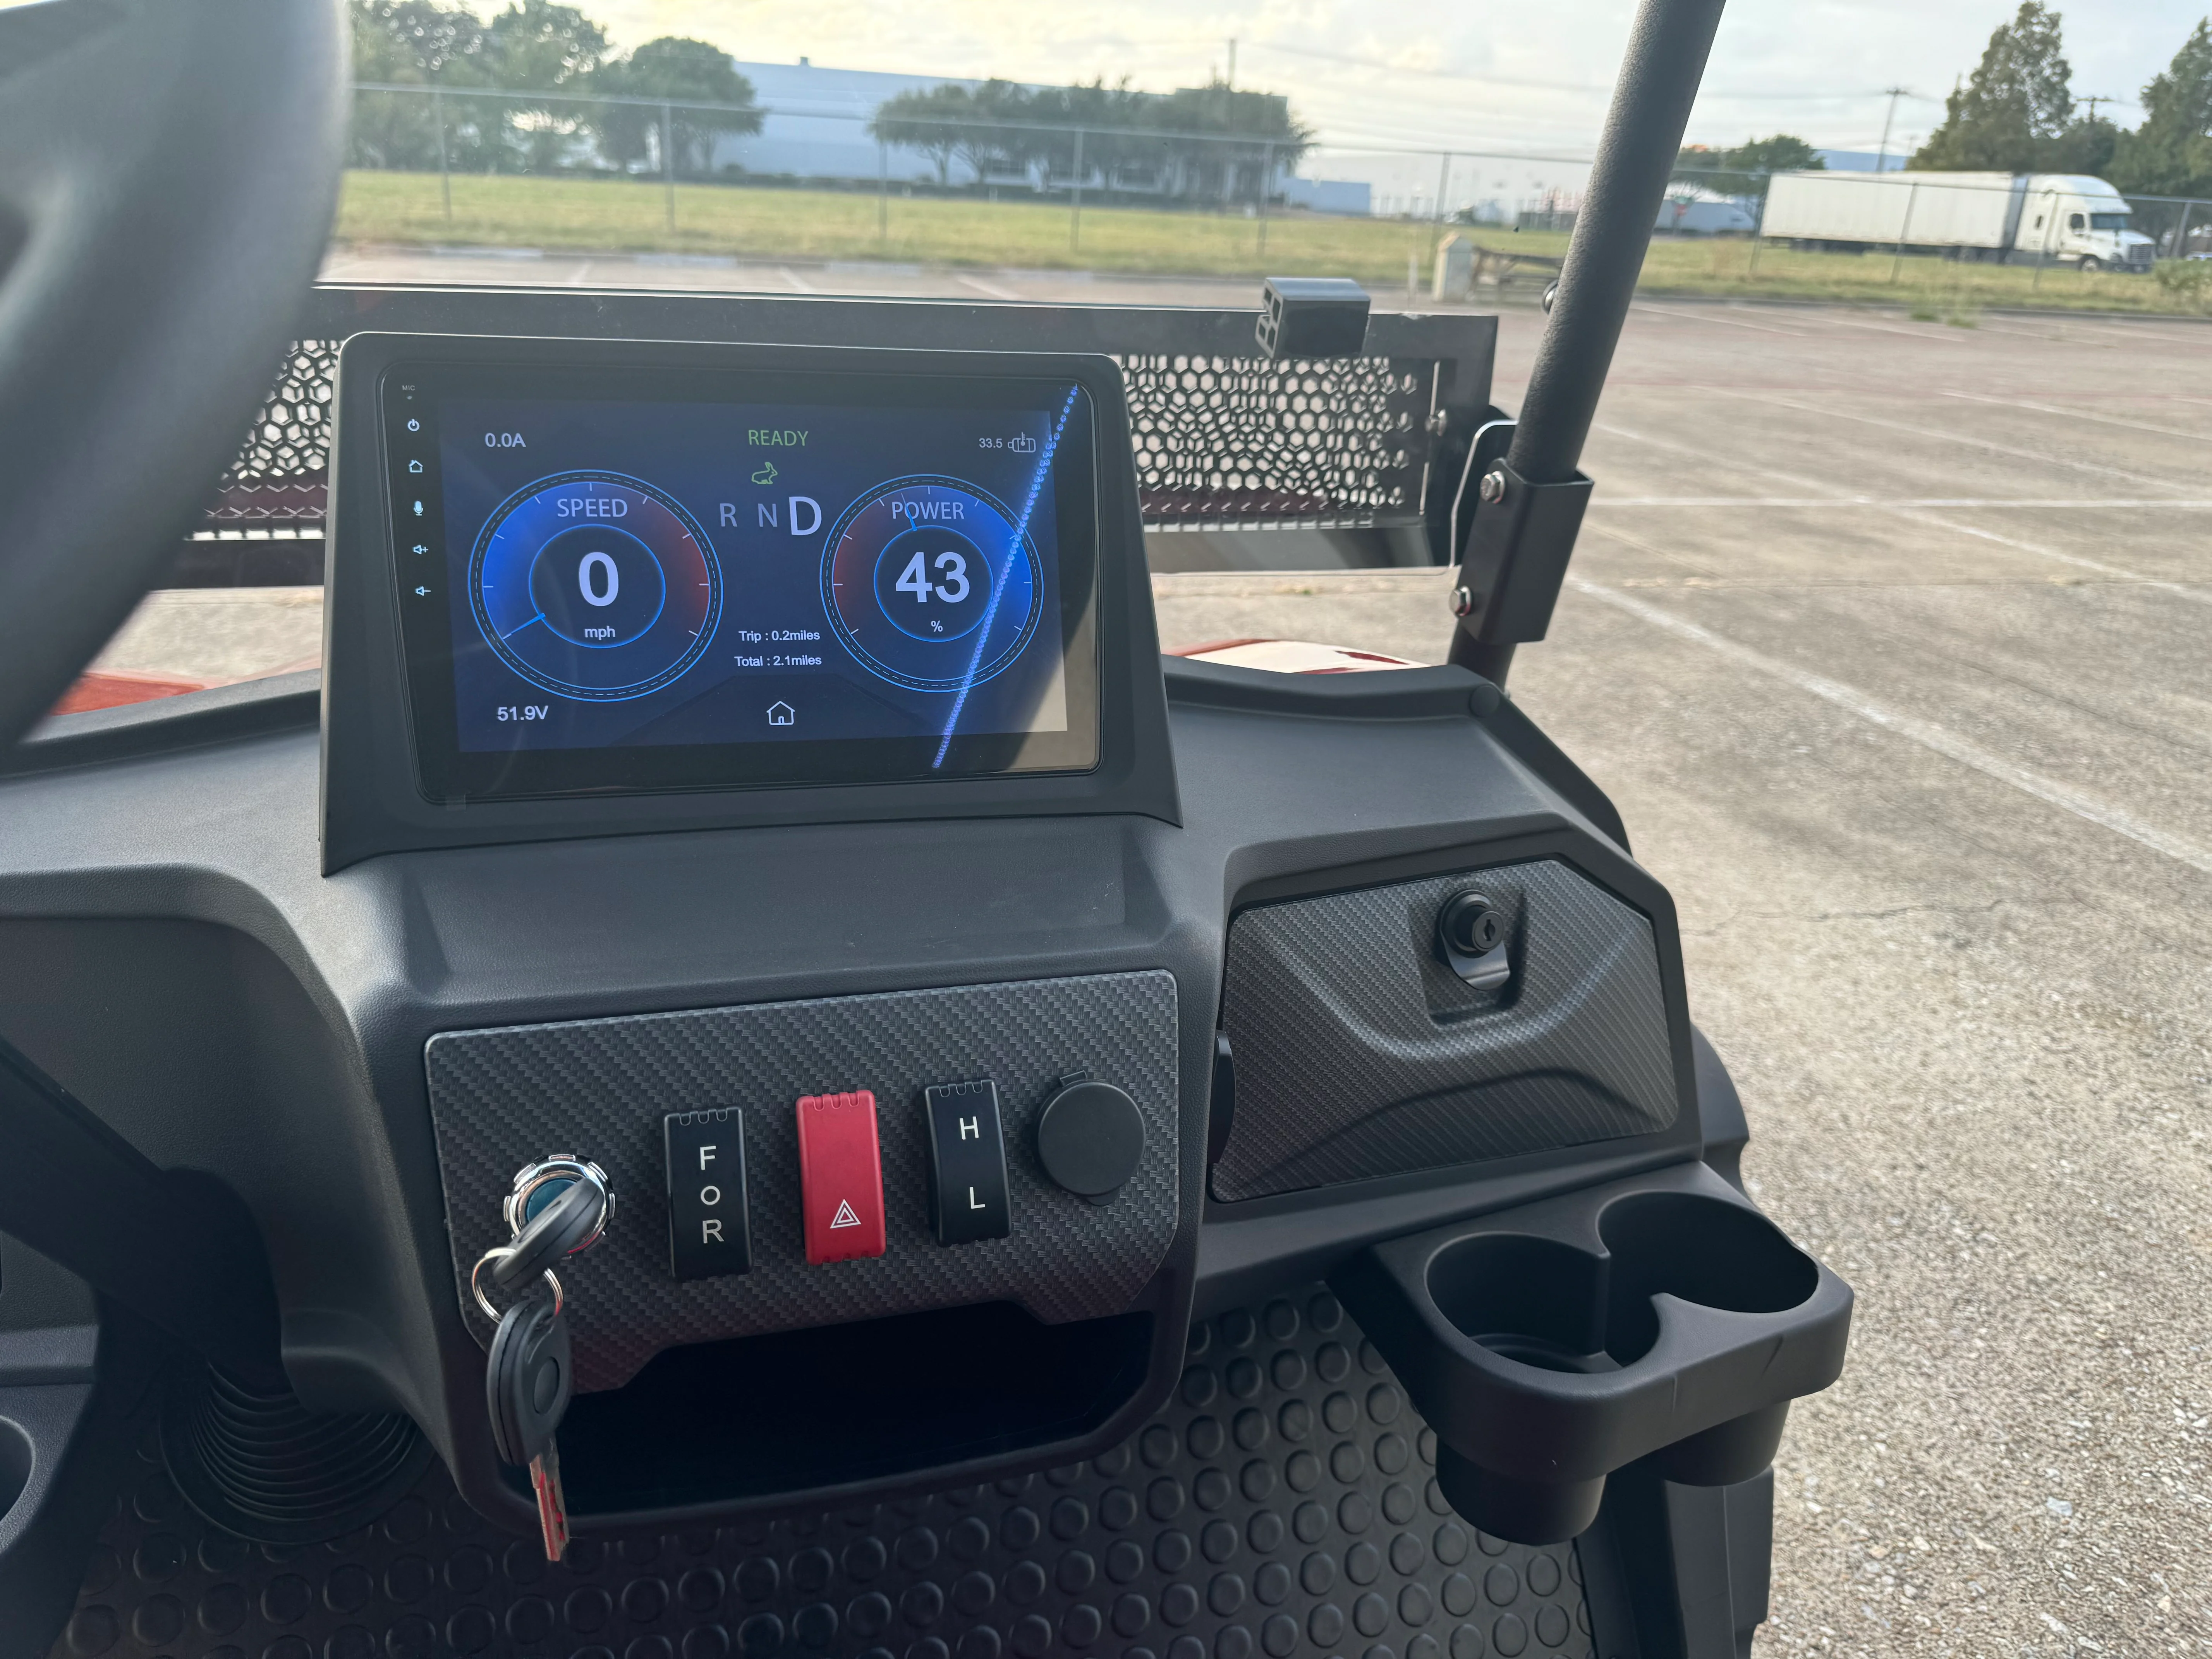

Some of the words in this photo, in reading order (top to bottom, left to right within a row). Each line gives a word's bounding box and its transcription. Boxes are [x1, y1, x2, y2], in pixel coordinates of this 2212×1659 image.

[484, 433, 527, 448] 0.0A
[748, 429, 809, 447] READY
[979, 437, 1003, 448] 33.5
[556, 498, 628, 518] SPEED
[719, 503, 738, 527] R
[757, 503, 778, 527] N
[788, 496, 822, 536] D
[891, 501, 965, 520] POWER
[578, 551, 619, 607] 0
[895, 551, 970, 603] 43
[584, 625, 616, 641] mph
[931, 620, 943, 632] %
[738, 630, 762, 644] Trip
[771, 629, 821, 641] 0.2miles
[734, 655, 764, 667] Total
[773, 654, 822, 666] 2.1miles
[497, 705, 549, 721] 51.9V
[959, 1116, 979, 1140] H
[699, 1145, 717, 1171] F
[969, 1186, 986, 1209] L
[702, 1219, 725, 1244] R
